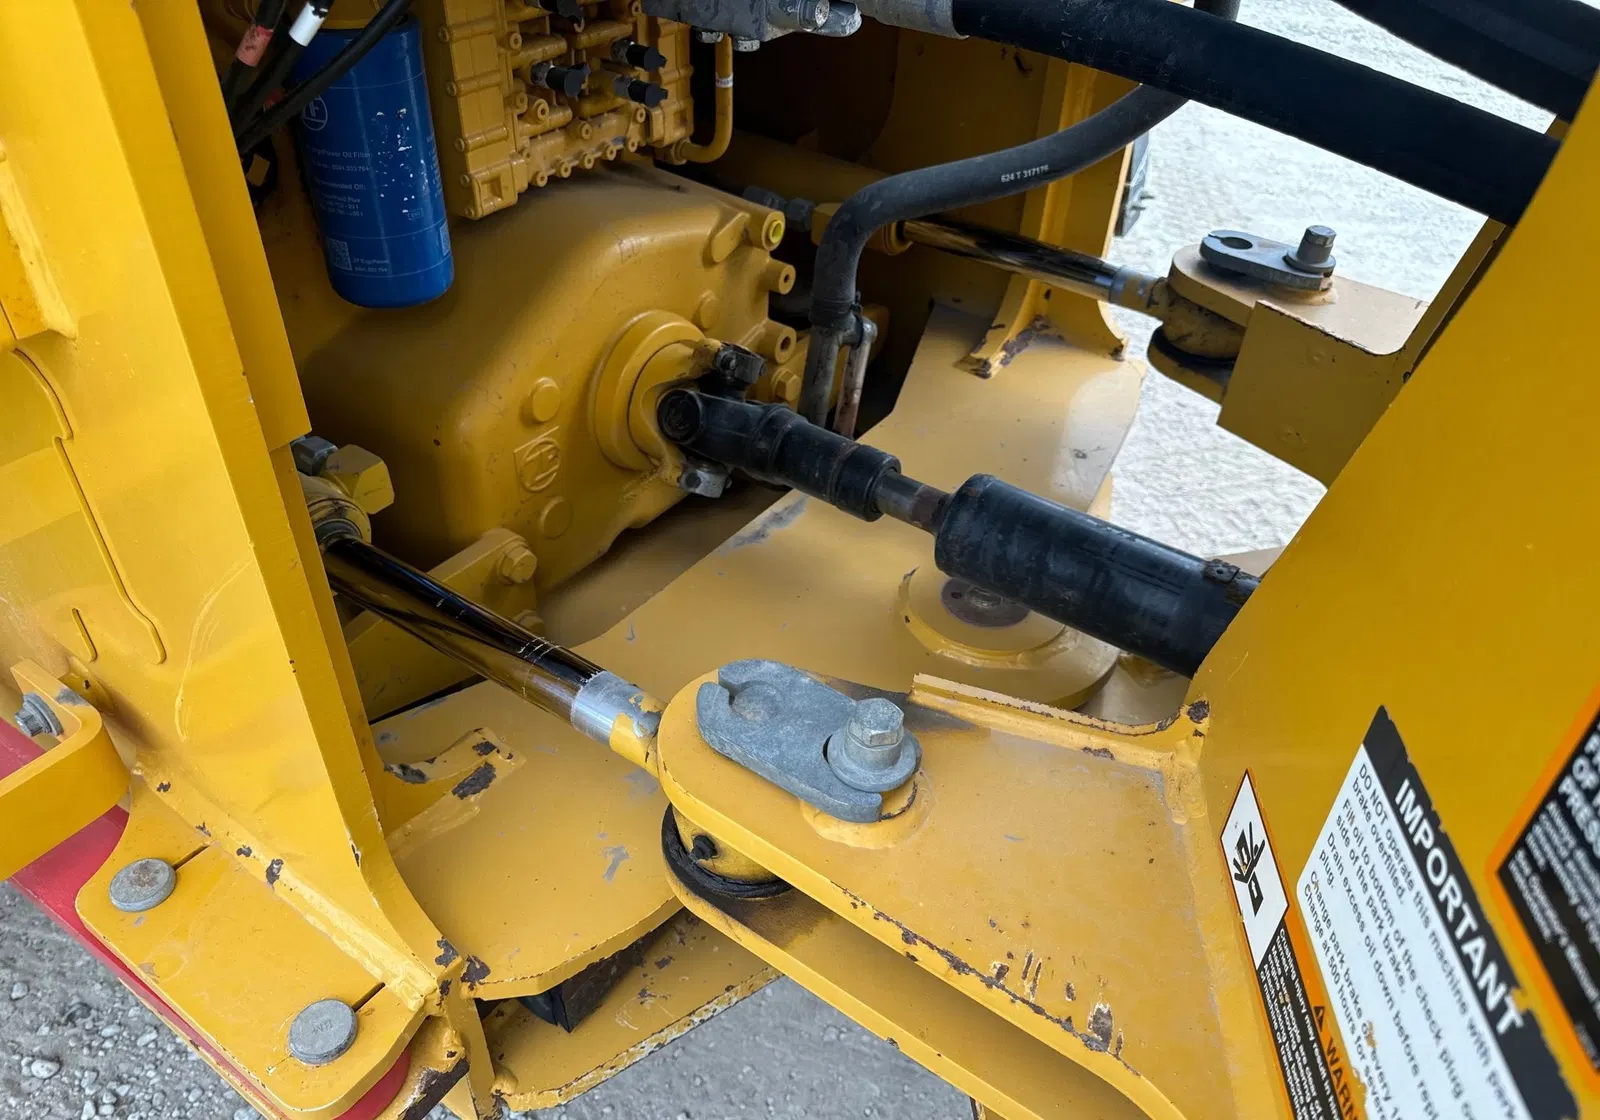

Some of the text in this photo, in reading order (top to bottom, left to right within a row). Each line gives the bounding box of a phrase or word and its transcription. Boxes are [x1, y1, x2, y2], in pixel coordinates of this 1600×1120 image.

[1319, 849, 1334, 888] plug.
[1336, 815, 1405, 993] side of the park brake.
[1352, 777, 1405, 904] brake overfilled.
[1359, 763, 1372, 790] DO
[1370, 788, 1388, 825] NOT
[1385, 828, 1414, 892] operate
[1413, 891, 1430, 929] this
[1428, 930, 1468, 1015] machine
[1467, 1018, 1490, 1067] with
[1395, 779, 1523, 1033] IMPORTANT
[1263, 983, 1278, 1030] machine
[1263, 964, 1275, 999] Attach
[1273, 998, 1287, 1042] locking
[1285, 1041, 1293, 1061] bar
[1291, 1063, 1304, 1104] before
[1268, 954, 1280, 990] engine
[1282, 1005, 1297, 1051] moving
[1271, 945, 1281, 975] Make
[1287, 1001, 1301, 1043] people
[1299, 1044, 1307, 1065] are
[1305, 1066, 1316, 1096] clear
[1276, 935, 1289, 976] turned.
[1280, 928, 1296, 980] Crushing
[1294, 978, 1307, 1013] injury
[1304, 1014, 1315, 1041] may
[1313, 1043, 1326, 1080] result
[1324, 1080, 1330, 1095] in
[1304, 883, 1323, 938] Change
[1322, 940, 1330, 957] at
[1328, 955, 1340, 985] 500
[1338, 984, 1356, 1035] hours
[1354, 1035, 1365, 1060] for
[1310, 871, 1331, 929] Change
[1329, 930, 1345, 969] park
[1343, 967, 1362, 1019] brake
[1371, 1042, 1392, 1102] every
[1327, 832, 1344, 876] Drain
[1343, 876, 1365, 933] excess
[1364, 935, 1376, 958] oil
[1373, 960, 1394, 1010] down
[1393, 1010, 1419, 1077] before
[1353, 826, 1364, 847] oil
[1361, 846, 1370, 865] to
[1369, 864, 1395, 927] bottom
[1393, 929, 1405, 948] of
[1402, 949, 1416, 982] the
[1415, 985, 1442, 1045] check
[1438, 1048, 1464, 1099] plug
